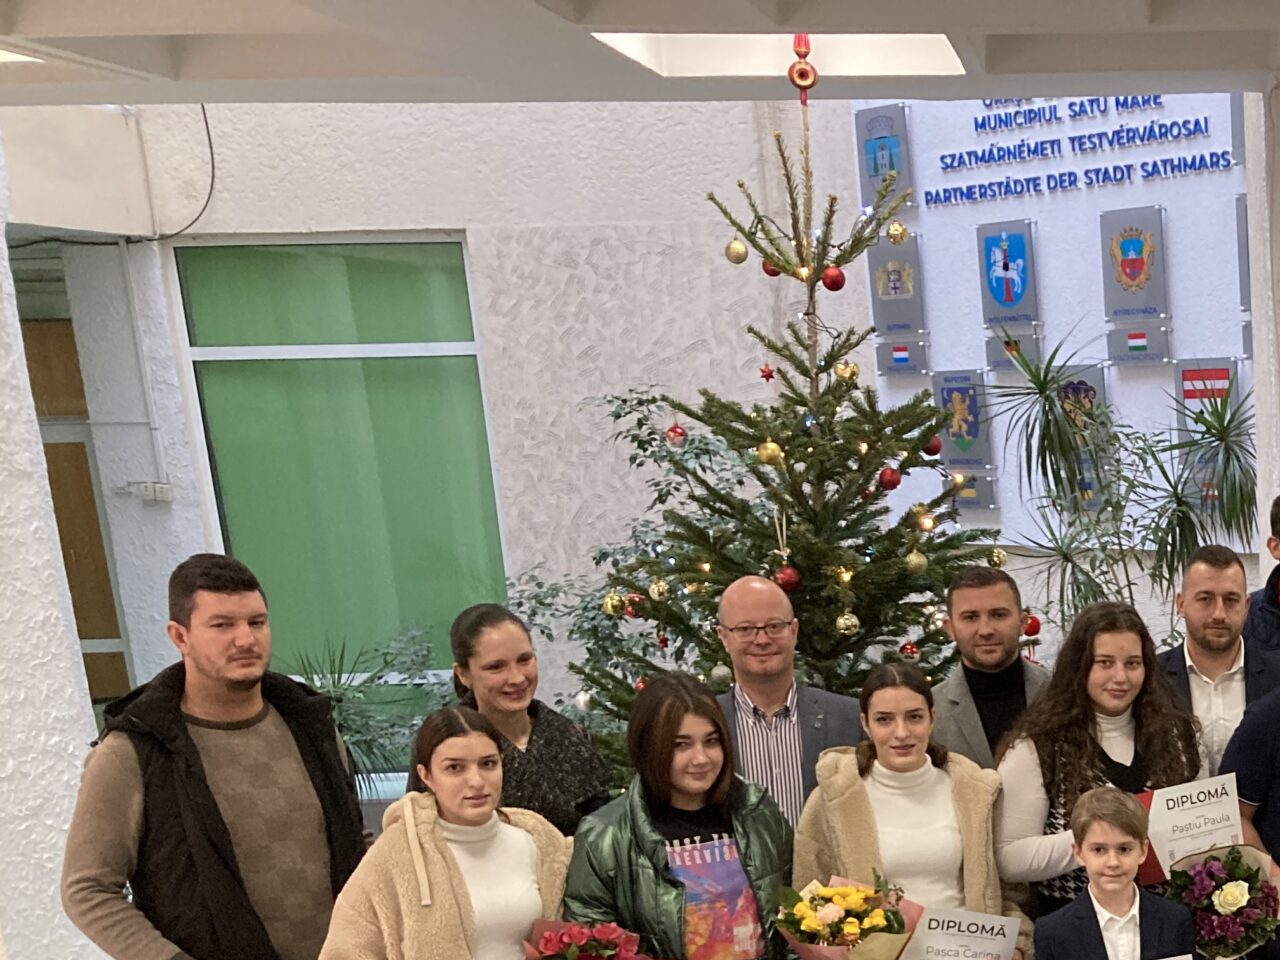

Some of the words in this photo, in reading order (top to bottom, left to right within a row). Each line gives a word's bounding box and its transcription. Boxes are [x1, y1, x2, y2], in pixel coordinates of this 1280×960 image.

[974, 105, 1062, 132] MUNICIPIUL
[1068, 97, 1108, 119] SATU
[1115, 94, 1162, 111] MARE
[940, 139, 1061, 170] SZATMÁRNÉMETI
[1068, 117, 1209, 153] TESTVÉRVÁROSAI
[925, 176, 1042, 206] PARTNERSTÄDTE
[1047, 171, 1078, 190] DER
[1084, 164, 1134, 186] STADT
[1140, 151, 1232, 180] SATHMARS
[1165, 783, 1229, 811] DIPLOMĂ
[1203, 812, 1231, 828] Paula
[927, 918, 1007, 938] DIPLOMĂ
